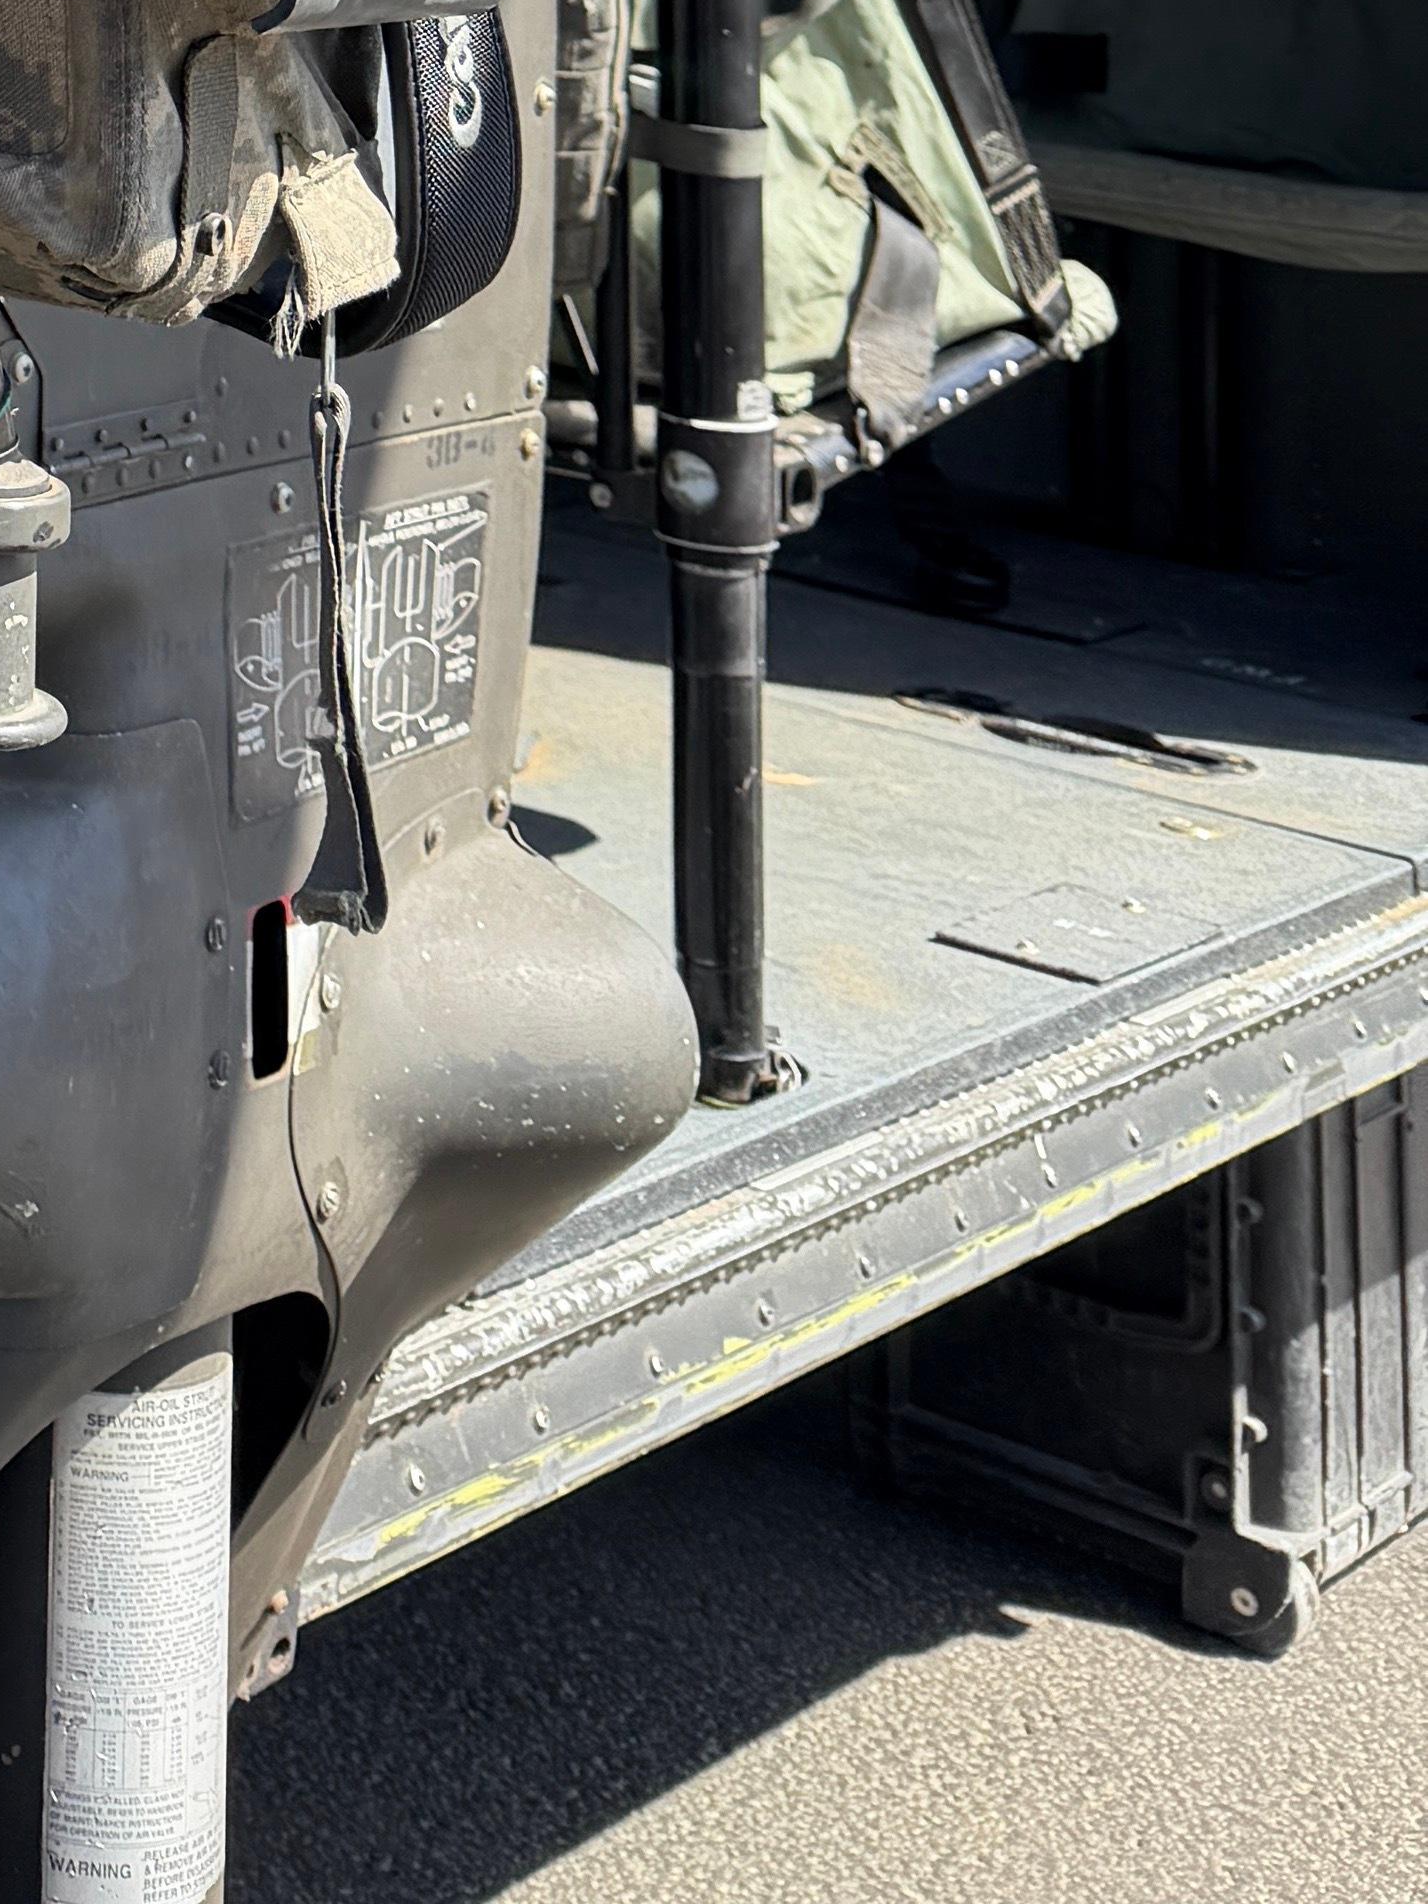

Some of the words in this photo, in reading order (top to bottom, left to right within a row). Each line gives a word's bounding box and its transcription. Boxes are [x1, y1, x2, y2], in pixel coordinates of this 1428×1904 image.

[131, 1396, 181, 1413] AIR-OIL
[87, 1413, 166, 1430] SERVICING
[70, 1466, 130, 1483] WARNING
[112, 1619, 125, 1630] TO
[143, 1843, 189, 1863] RELEASE
[48, 1855, 133, 1880] WARNING
[143, 1871, 185, 1890] BEFORE
[143, 1885, 179, 1904] REFER
